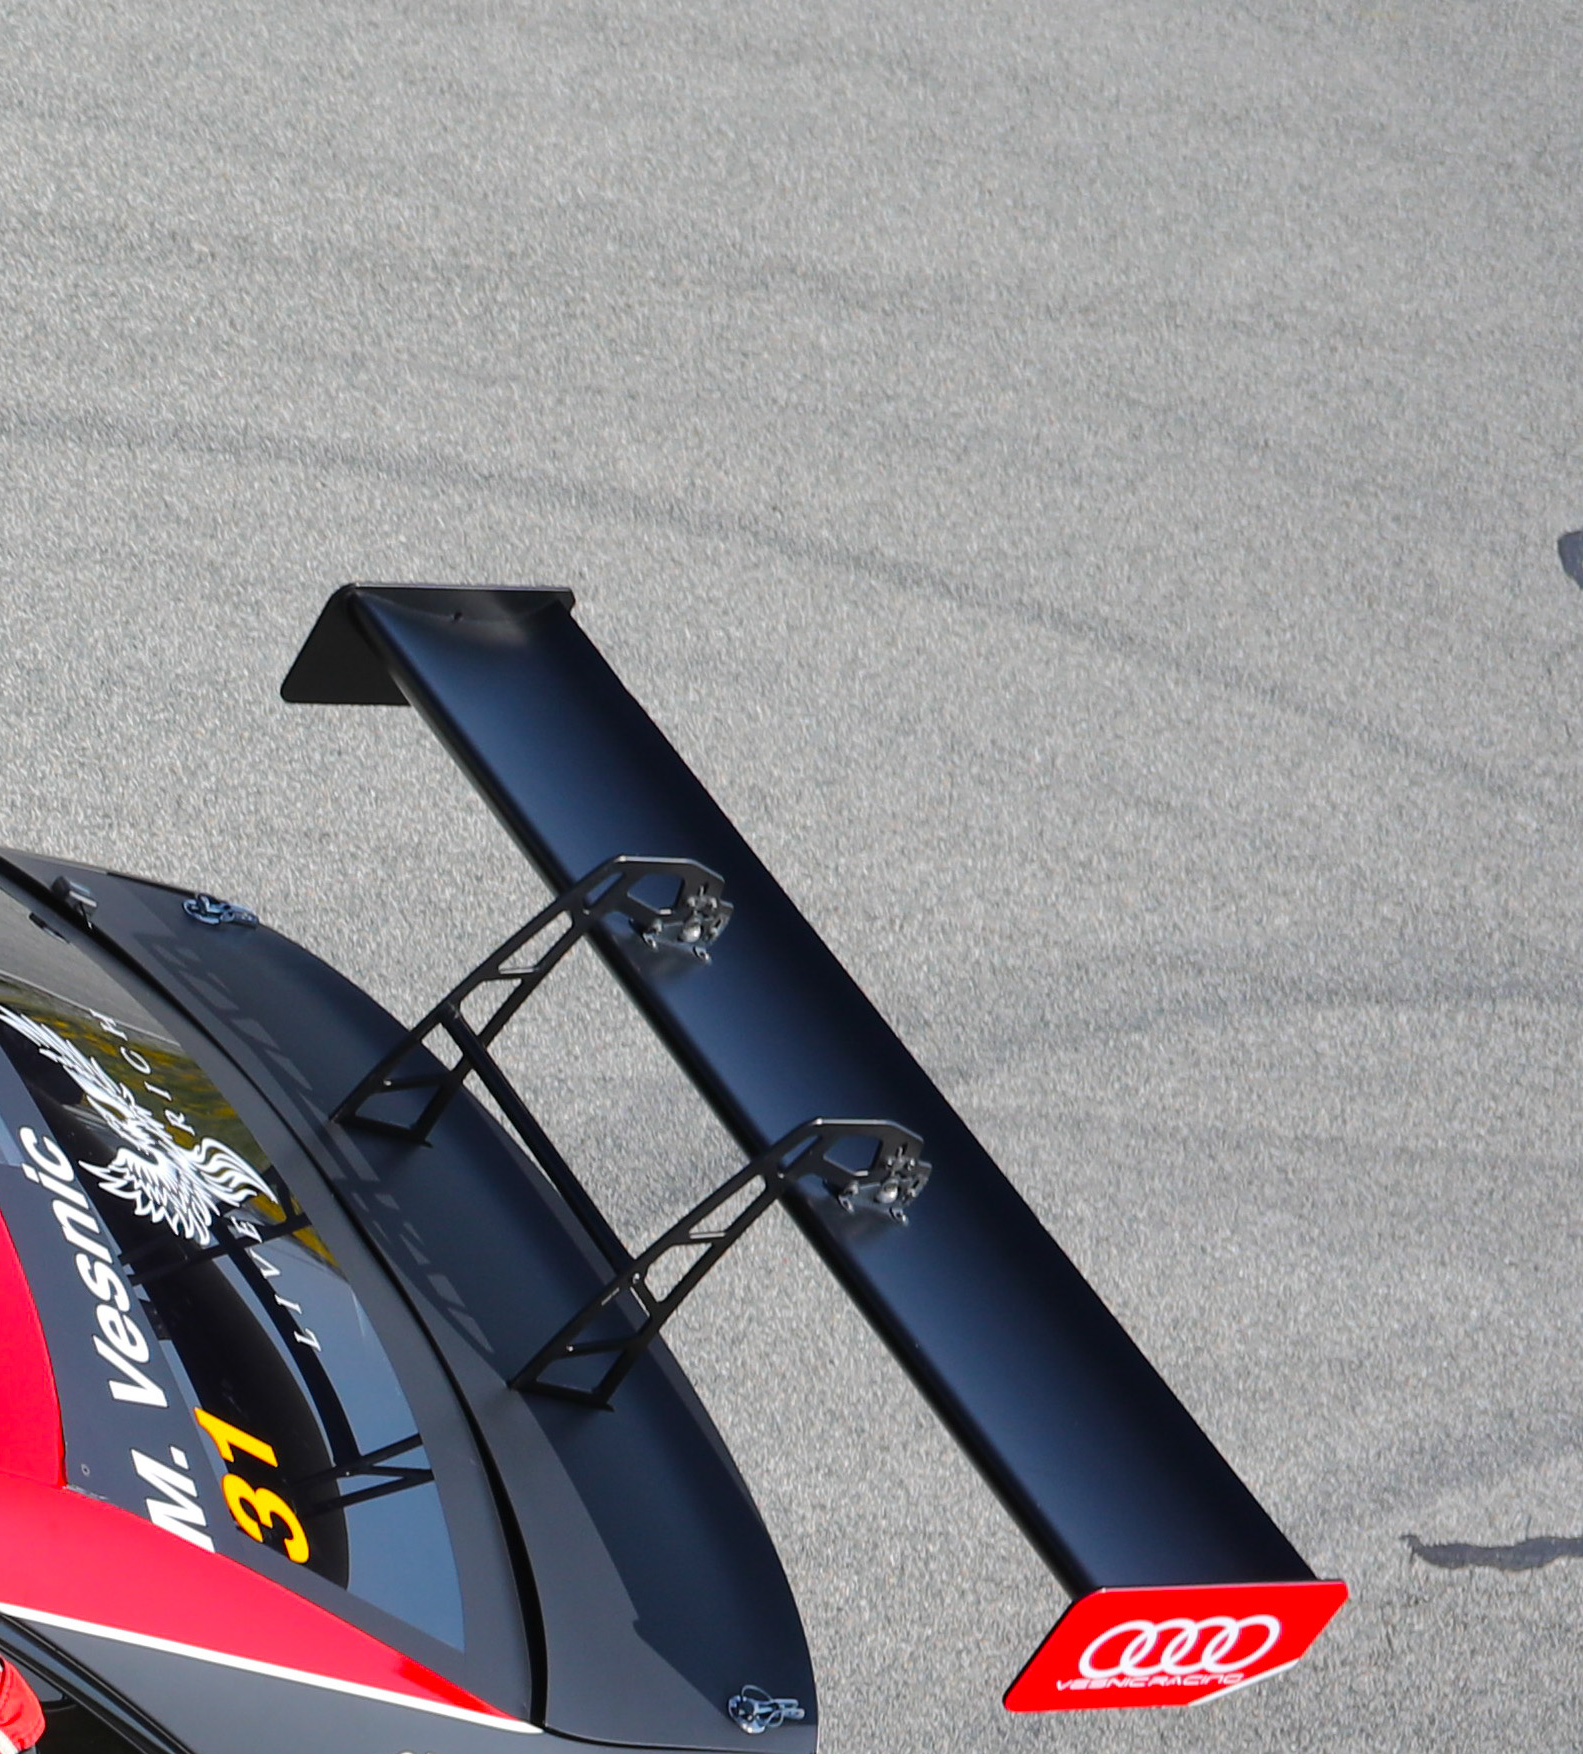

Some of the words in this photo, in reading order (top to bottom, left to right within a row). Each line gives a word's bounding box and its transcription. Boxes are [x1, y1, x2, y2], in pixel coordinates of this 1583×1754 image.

[89, 1008, 196, 1136] RICH
[19, 1126, 170, 1409] Vesnic
[228, 1215, 325, 1353] LIVE
[130, 1443, 217, 1553] M.
[195, 1407, 311, 1565] 31
[1056, 1677, 1149, 1691] VESNIC
[1147, 1673, 1245, 1688] RACING
